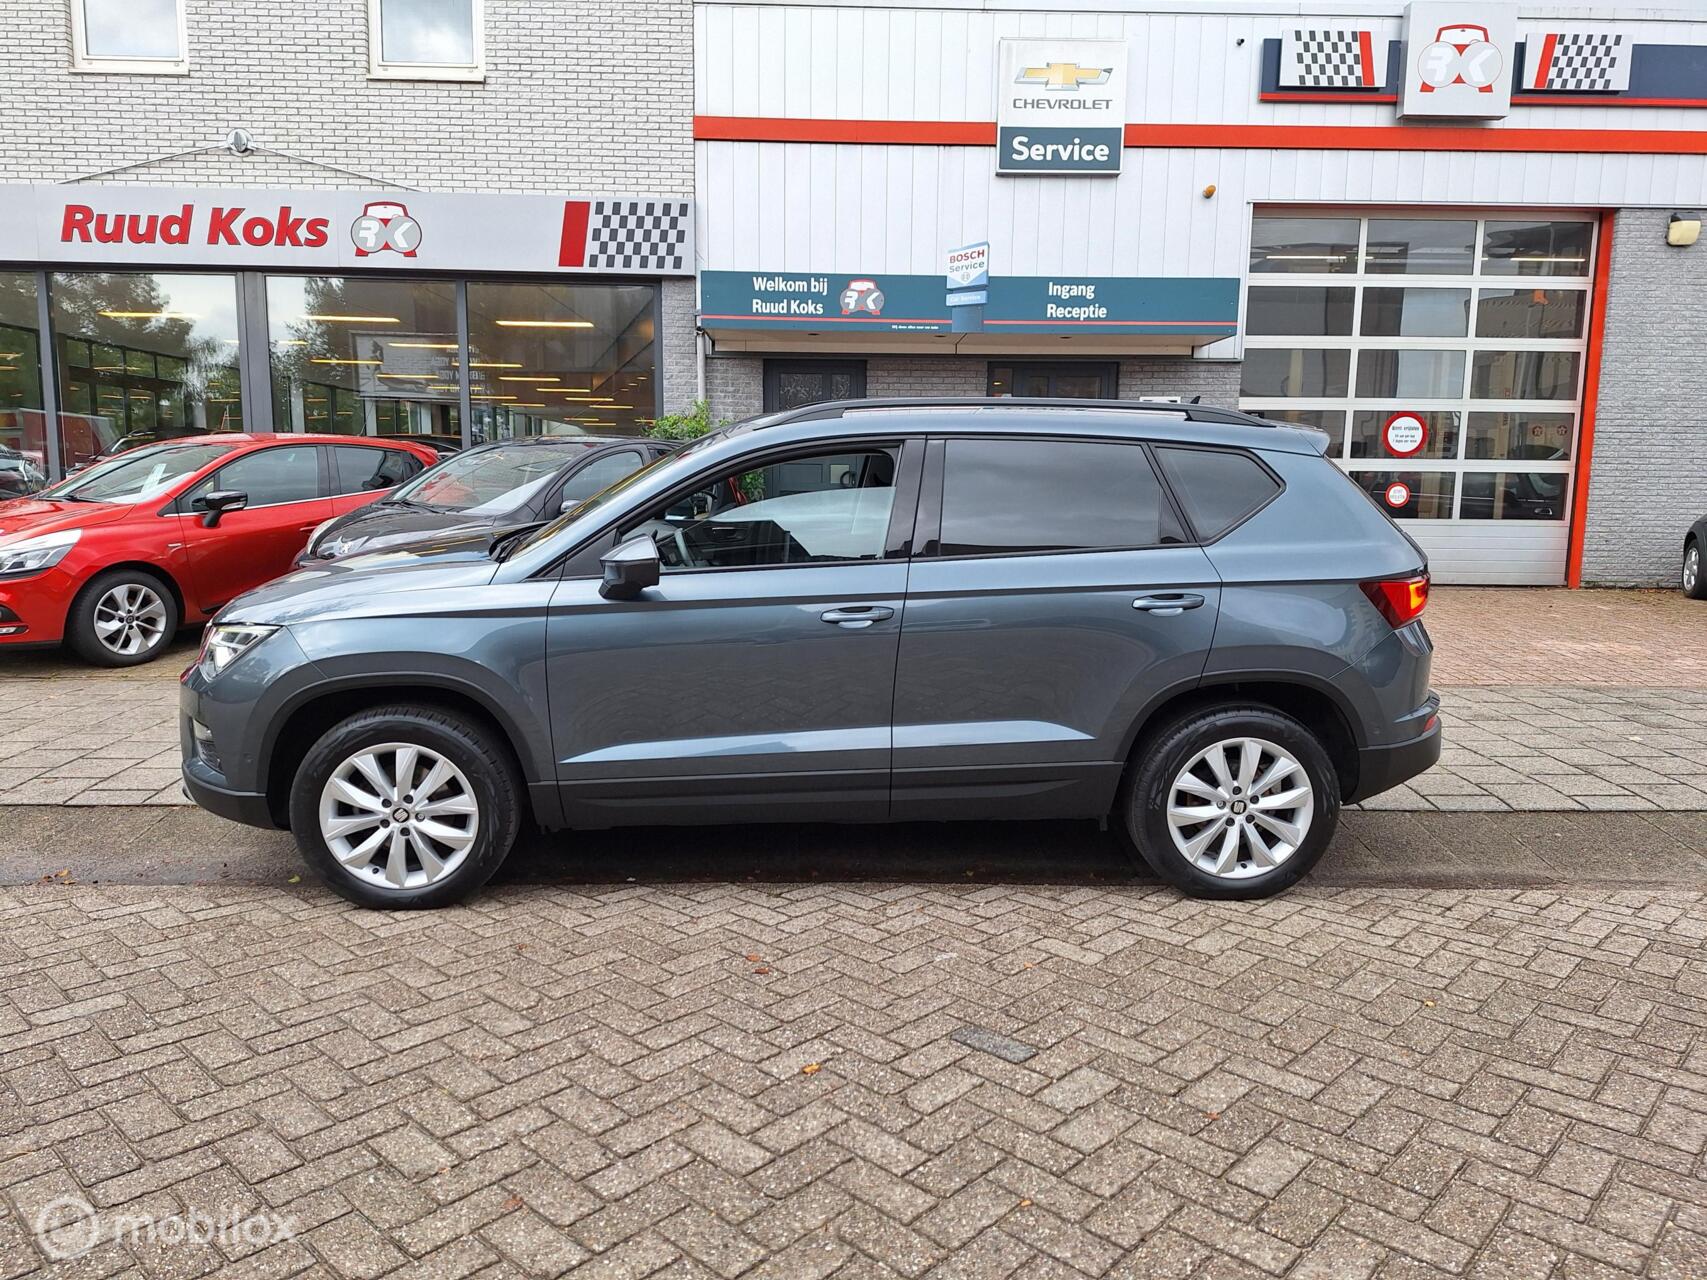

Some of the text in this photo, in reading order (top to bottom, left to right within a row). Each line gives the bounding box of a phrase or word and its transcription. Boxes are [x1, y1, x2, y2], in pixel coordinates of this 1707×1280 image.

[1013, 98, 1113, 110] CHEVROLET
[1012, 135, 1110, 161] Service
[60, 204, 329, 247] Ruud Koks
[949, 249, 985, 264] BOSCH
[949, 261, 985, 273] Service
[752, 276, 828, 296] Welkom bij
[1048, 281, 1096, 300] Ingang
[752, 298, 824, 315] Ruud Koks
[1046, 303, 1107, 321] Receptie
